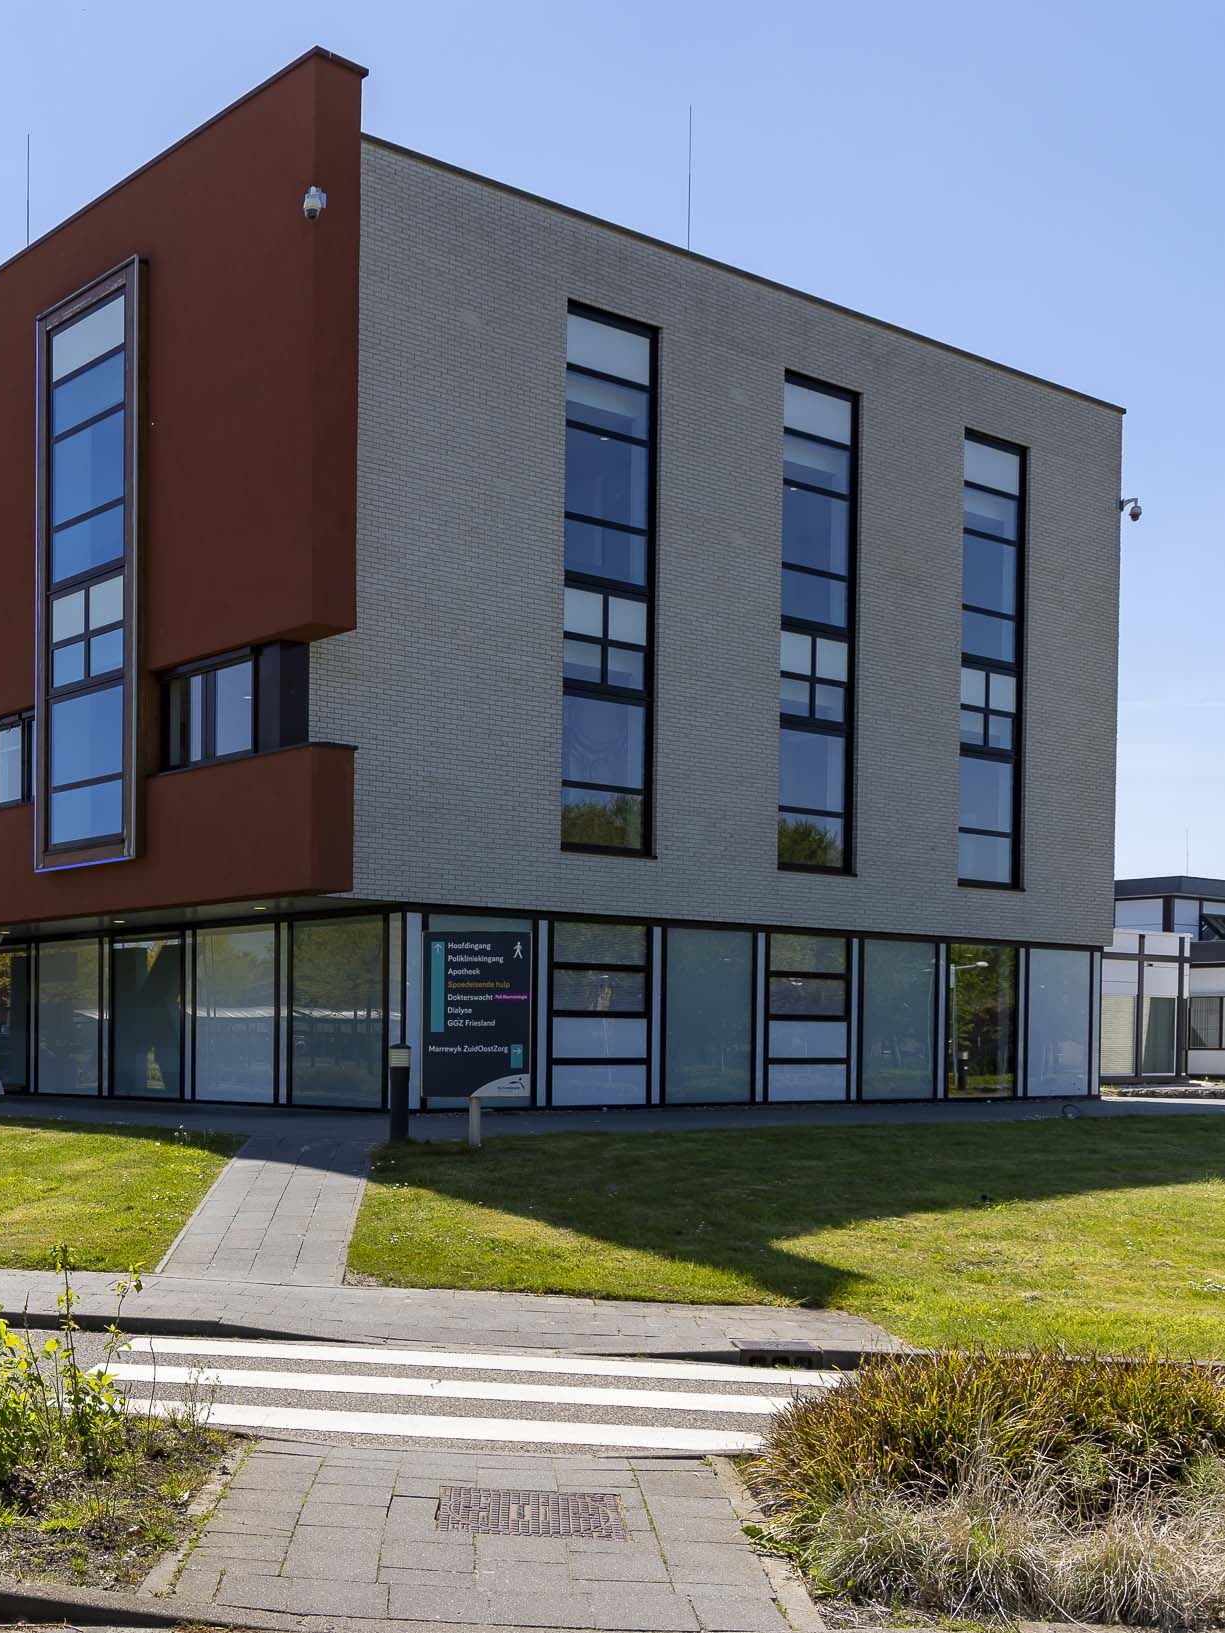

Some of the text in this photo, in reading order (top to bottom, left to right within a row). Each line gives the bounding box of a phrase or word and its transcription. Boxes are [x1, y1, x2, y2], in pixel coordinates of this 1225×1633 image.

[447, 941, 491, 951] Hoofdingang
[447, 955, 504, 964] Polikliniekingang
[447, 968, 481, 976] Apotheek
[447, 993, 493, 1001] Dokterswacht
[447, 1006, 473, 1015] Dialyse
[447, 1019, 496, 1027] GGZ Friesland
[463, 1045, 509, 1054] ZuidOostZorg
